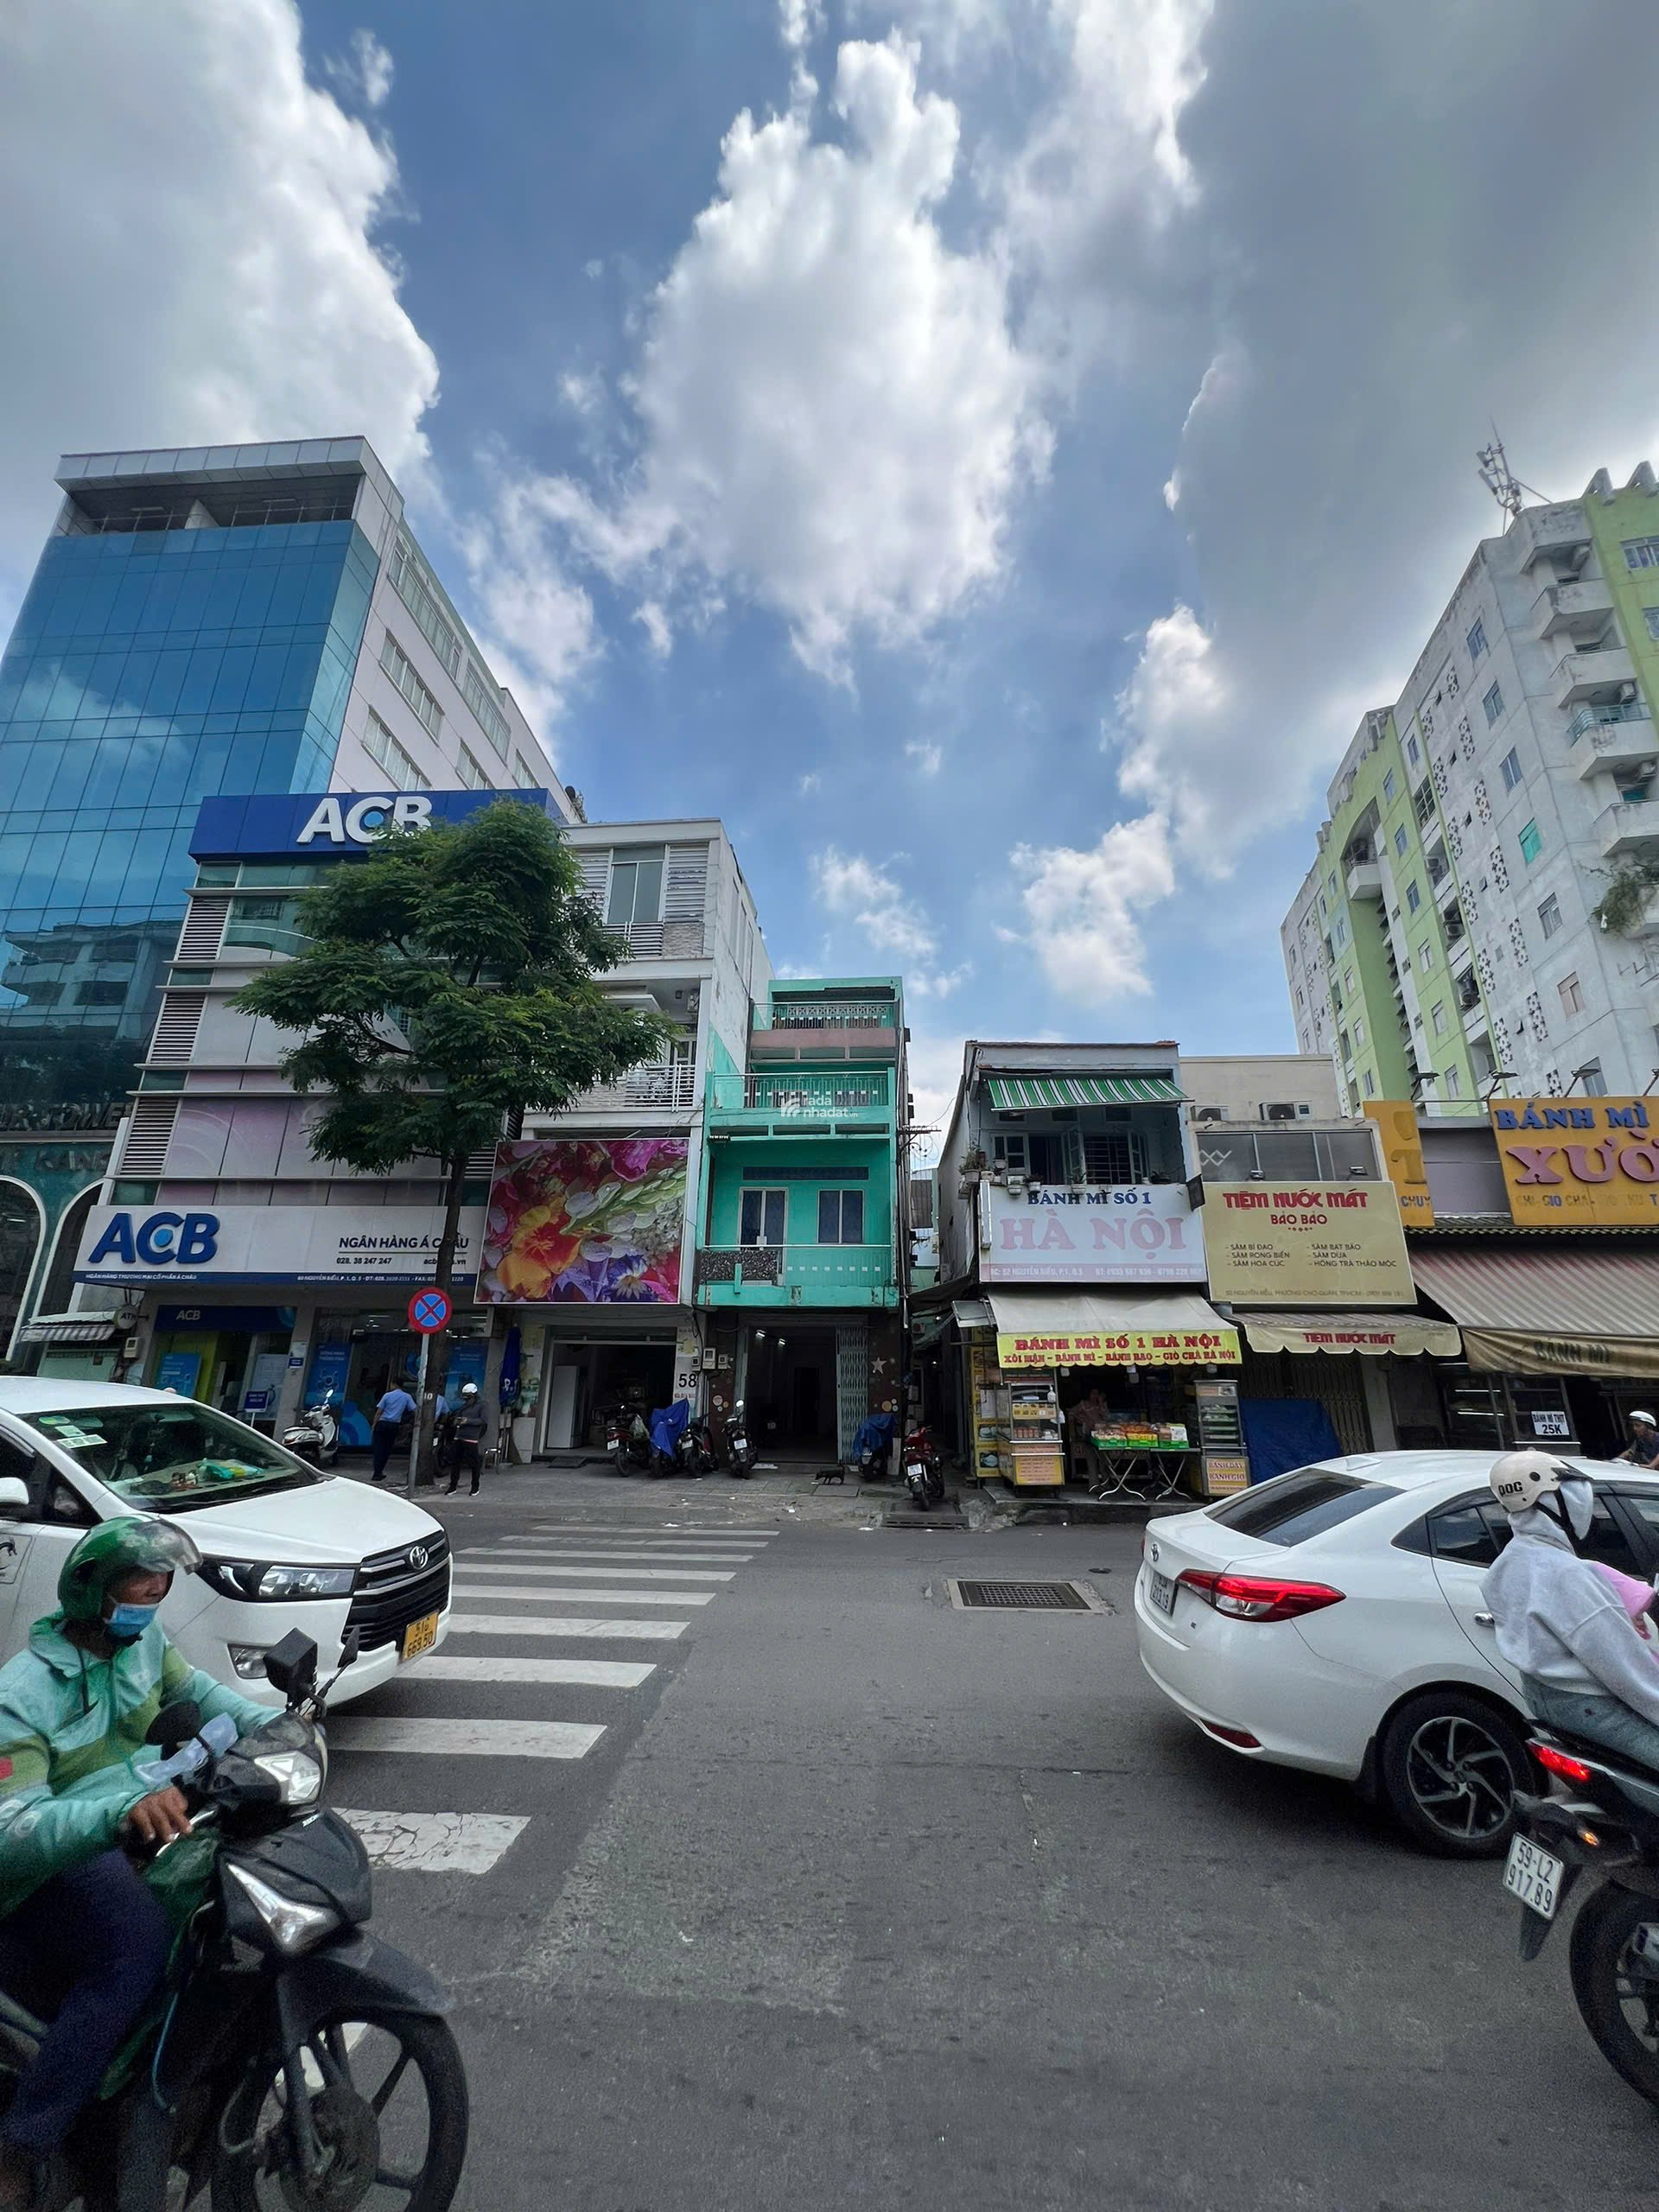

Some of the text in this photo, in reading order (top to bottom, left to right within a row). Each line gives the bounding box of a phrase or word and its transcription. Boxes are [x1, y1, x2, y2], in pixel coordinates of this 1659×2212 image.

[1494, 1101, 1649, 1129] BÁNH MÌ
[1027, 1190, 1083, 1205] BÁNH
[1114, 1187, 1138, 1205] SỐ
[1141, 1192, 1152, 1205] 1
[87, 1211, 220, 1265] ACB
[339, 1235, 377, 1249] NGÂN
[379, 1235, 417, 1249] HÀNG
[419, 1235, 429, 1249] Á
[999, 1208, 1187, 1260] HÀ NỘI
[175, 1309, 201, 1321] ACB
[1014, 1333, 1222, 1351] BÁNH MÌ SỐ 1 HÀ NỘI
[1003, 1353, 1022, 1363] XÔI
[1055, 1352, 1081, 1363] BÁNH
[1105, 1351, 1131, 1362] BÁNH
[1133, 1352, 1154, 1361] BAO
[1162, 1350, 1179, 1361] GIÒ
[1219, 1349, 1236, 1361] NỘI
[678, 1373, 697, 1388] 58
[1541, 1424, 1562, 1434] 25K
[1517, 1840, 1554, 1885] 59-L2
[1508, 1865, 1553, 1912] 917.89
